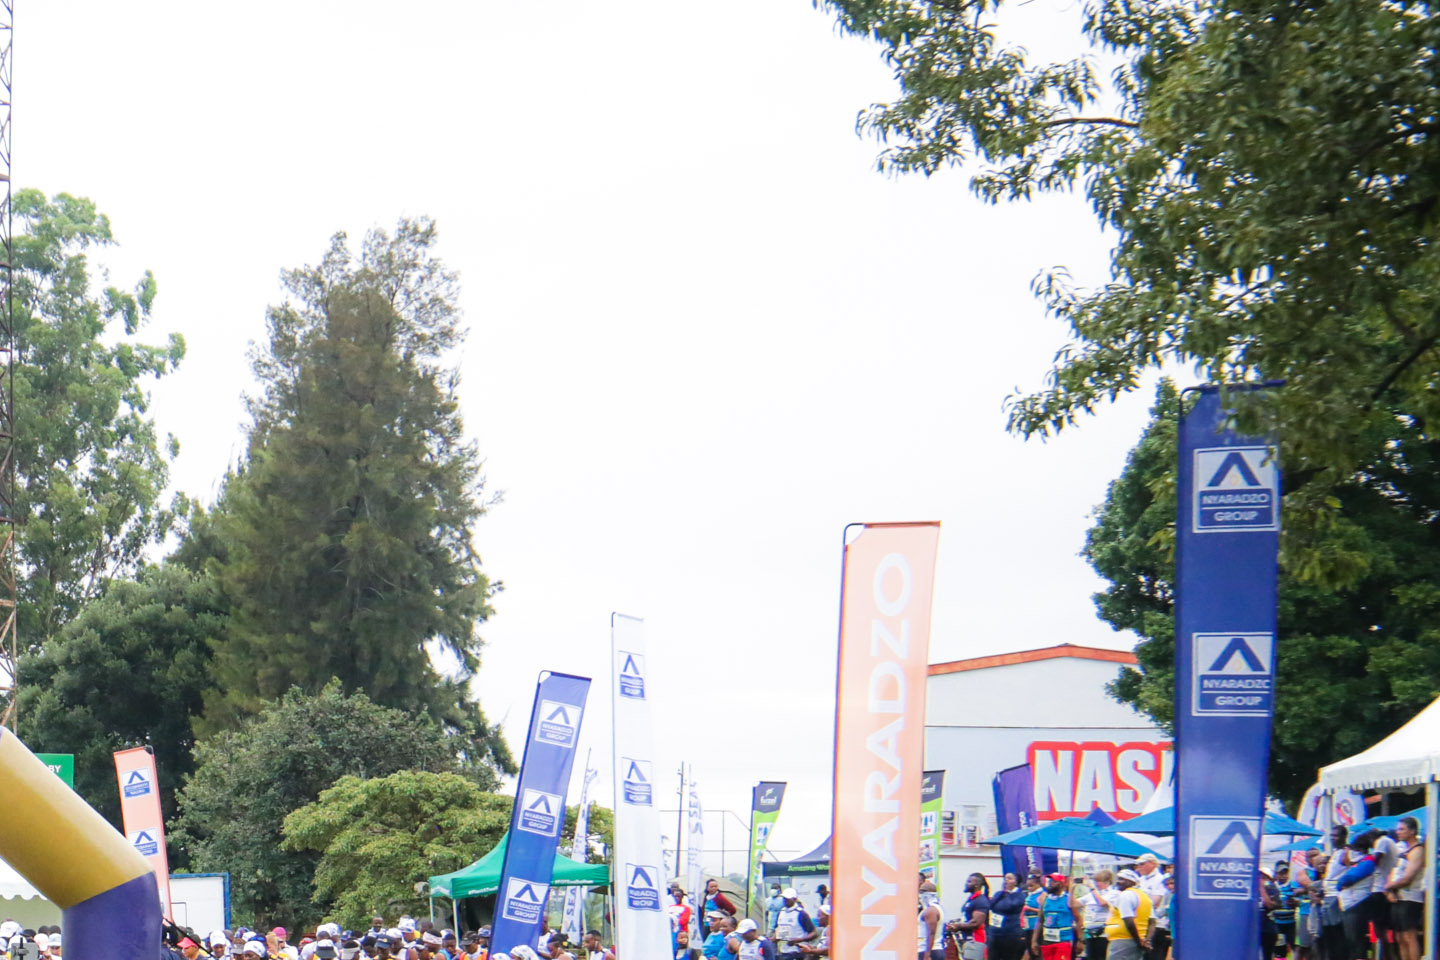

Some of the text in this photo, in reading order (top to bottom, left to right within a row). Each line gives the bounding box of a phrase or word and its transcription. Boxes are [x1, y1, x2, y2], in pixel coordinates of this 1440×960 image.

[1202, 494, 1268, 504] NYARADZO
[1214, 511, 1258, 522] GROUP
[1215, 696, 1262, 706] GROUP
[1200, 862, 1254, 872] NYARAD
[514, 909, 537, 919] GROUP
